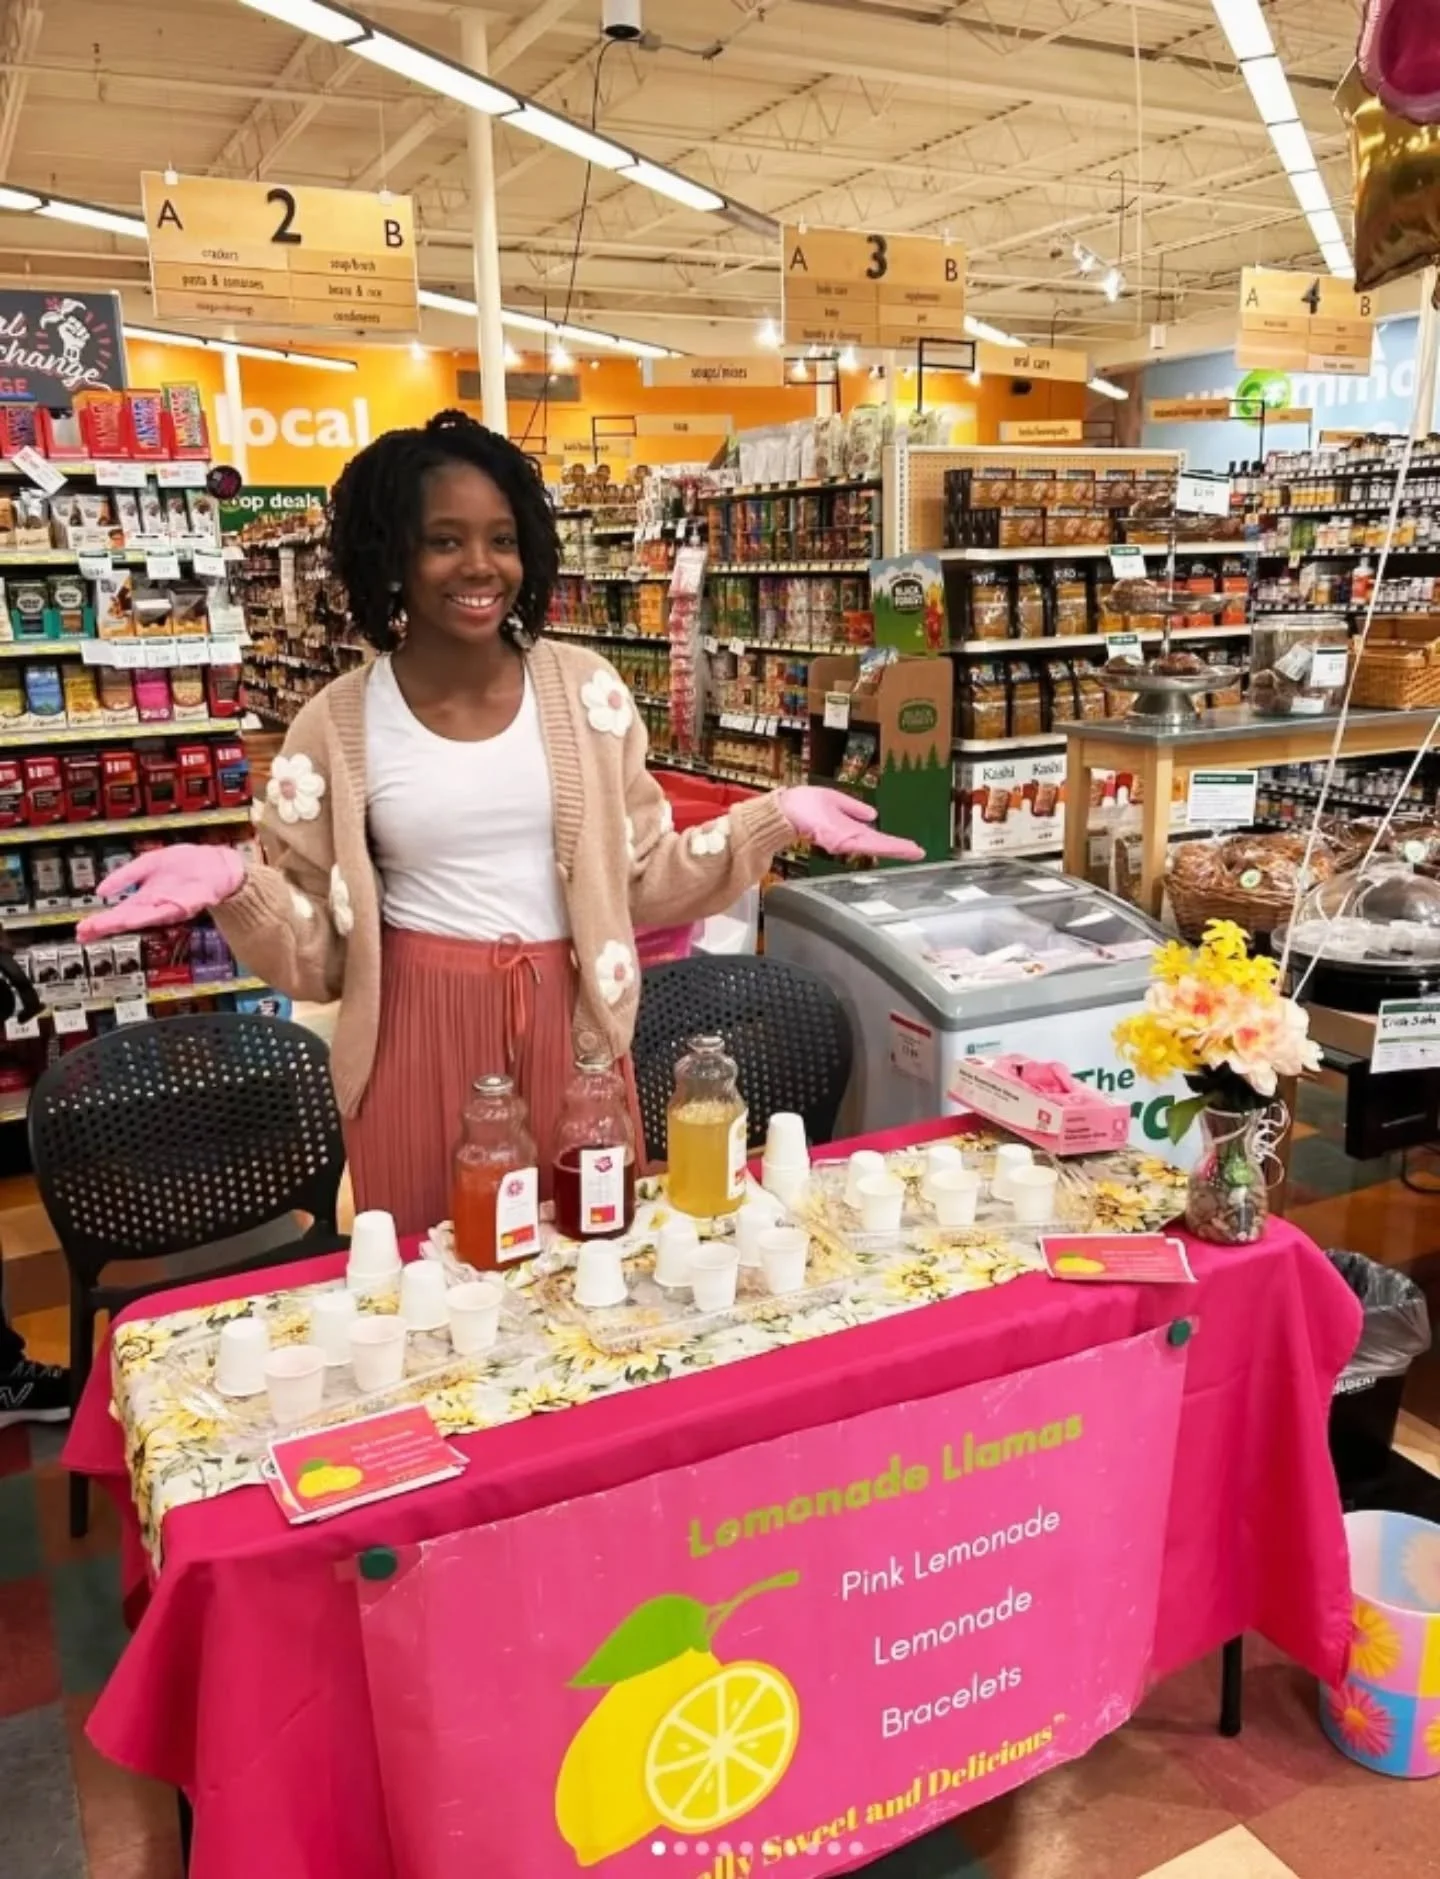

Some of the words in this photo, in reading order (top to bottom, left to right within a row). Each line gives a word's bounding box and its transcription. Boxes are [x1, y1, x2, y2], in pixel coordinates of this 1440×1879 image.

[157, 200, 183, 231] A
[267, 188, 302, 245] 2
[384, 220, 404, 248] B
[790, 247, 808, 271] A
[866, 234, 888, 280] 3
[945, 258, 958, 282] B
[1246, 287, 1259, 307] A
[1301, 278, 1321, 314] 4
[1360, 296, 1371, 317] B
[215, 392, 370, 448] local
[269, 491, 321, 509] deals
[983, 765, 1015, 780] Kashi
[1032, 762, 1064, 776] Kashi
[688, 1454, 930, 1560] Lemonade
[942, 1413, 1084, 1483] Llamas
[841, 1555, 905, 1601] Pink
[914, 1504, 1061, 1581] Lemonade
[873, 1585, 1033, 1666] Lemonade
[881, 1664, 1023, 1740] Bracelets
[761, 1805, 858, 1867] Sweet
[866, 1777, 922, 1825] and
